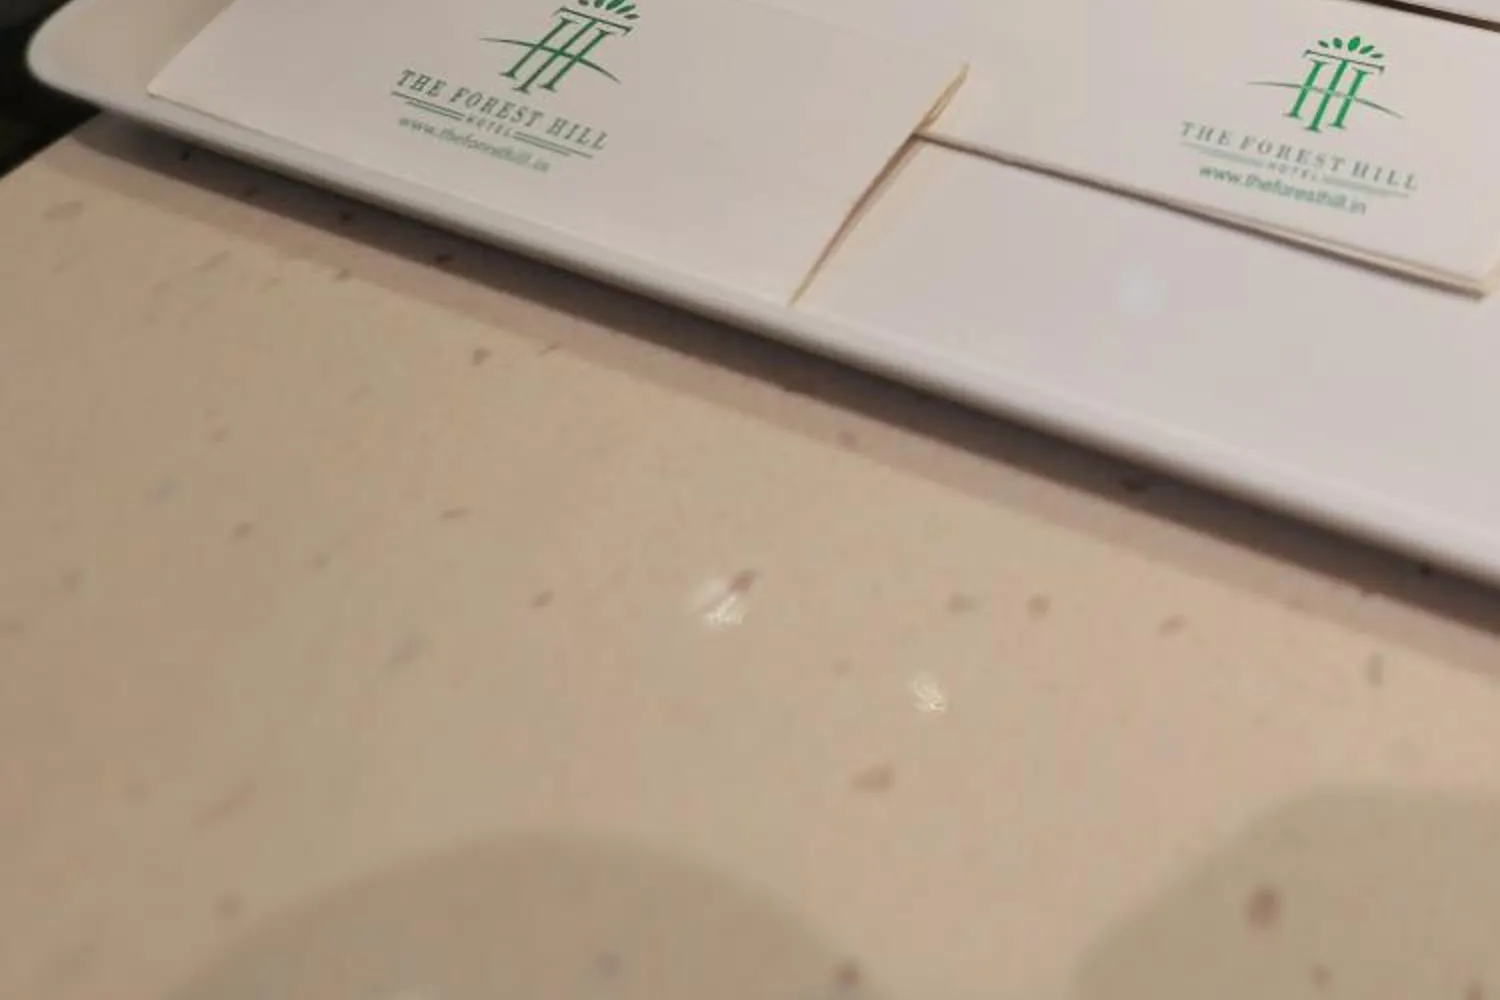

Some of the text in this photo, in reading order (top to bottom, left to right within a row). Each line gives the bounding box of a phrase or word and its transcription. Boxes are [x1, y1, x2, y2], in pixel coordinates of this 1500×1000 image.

[396, 68, 609, 151] THE FOREST HILL
[1180, 120, 1419, 191] THE FOREST HILL
